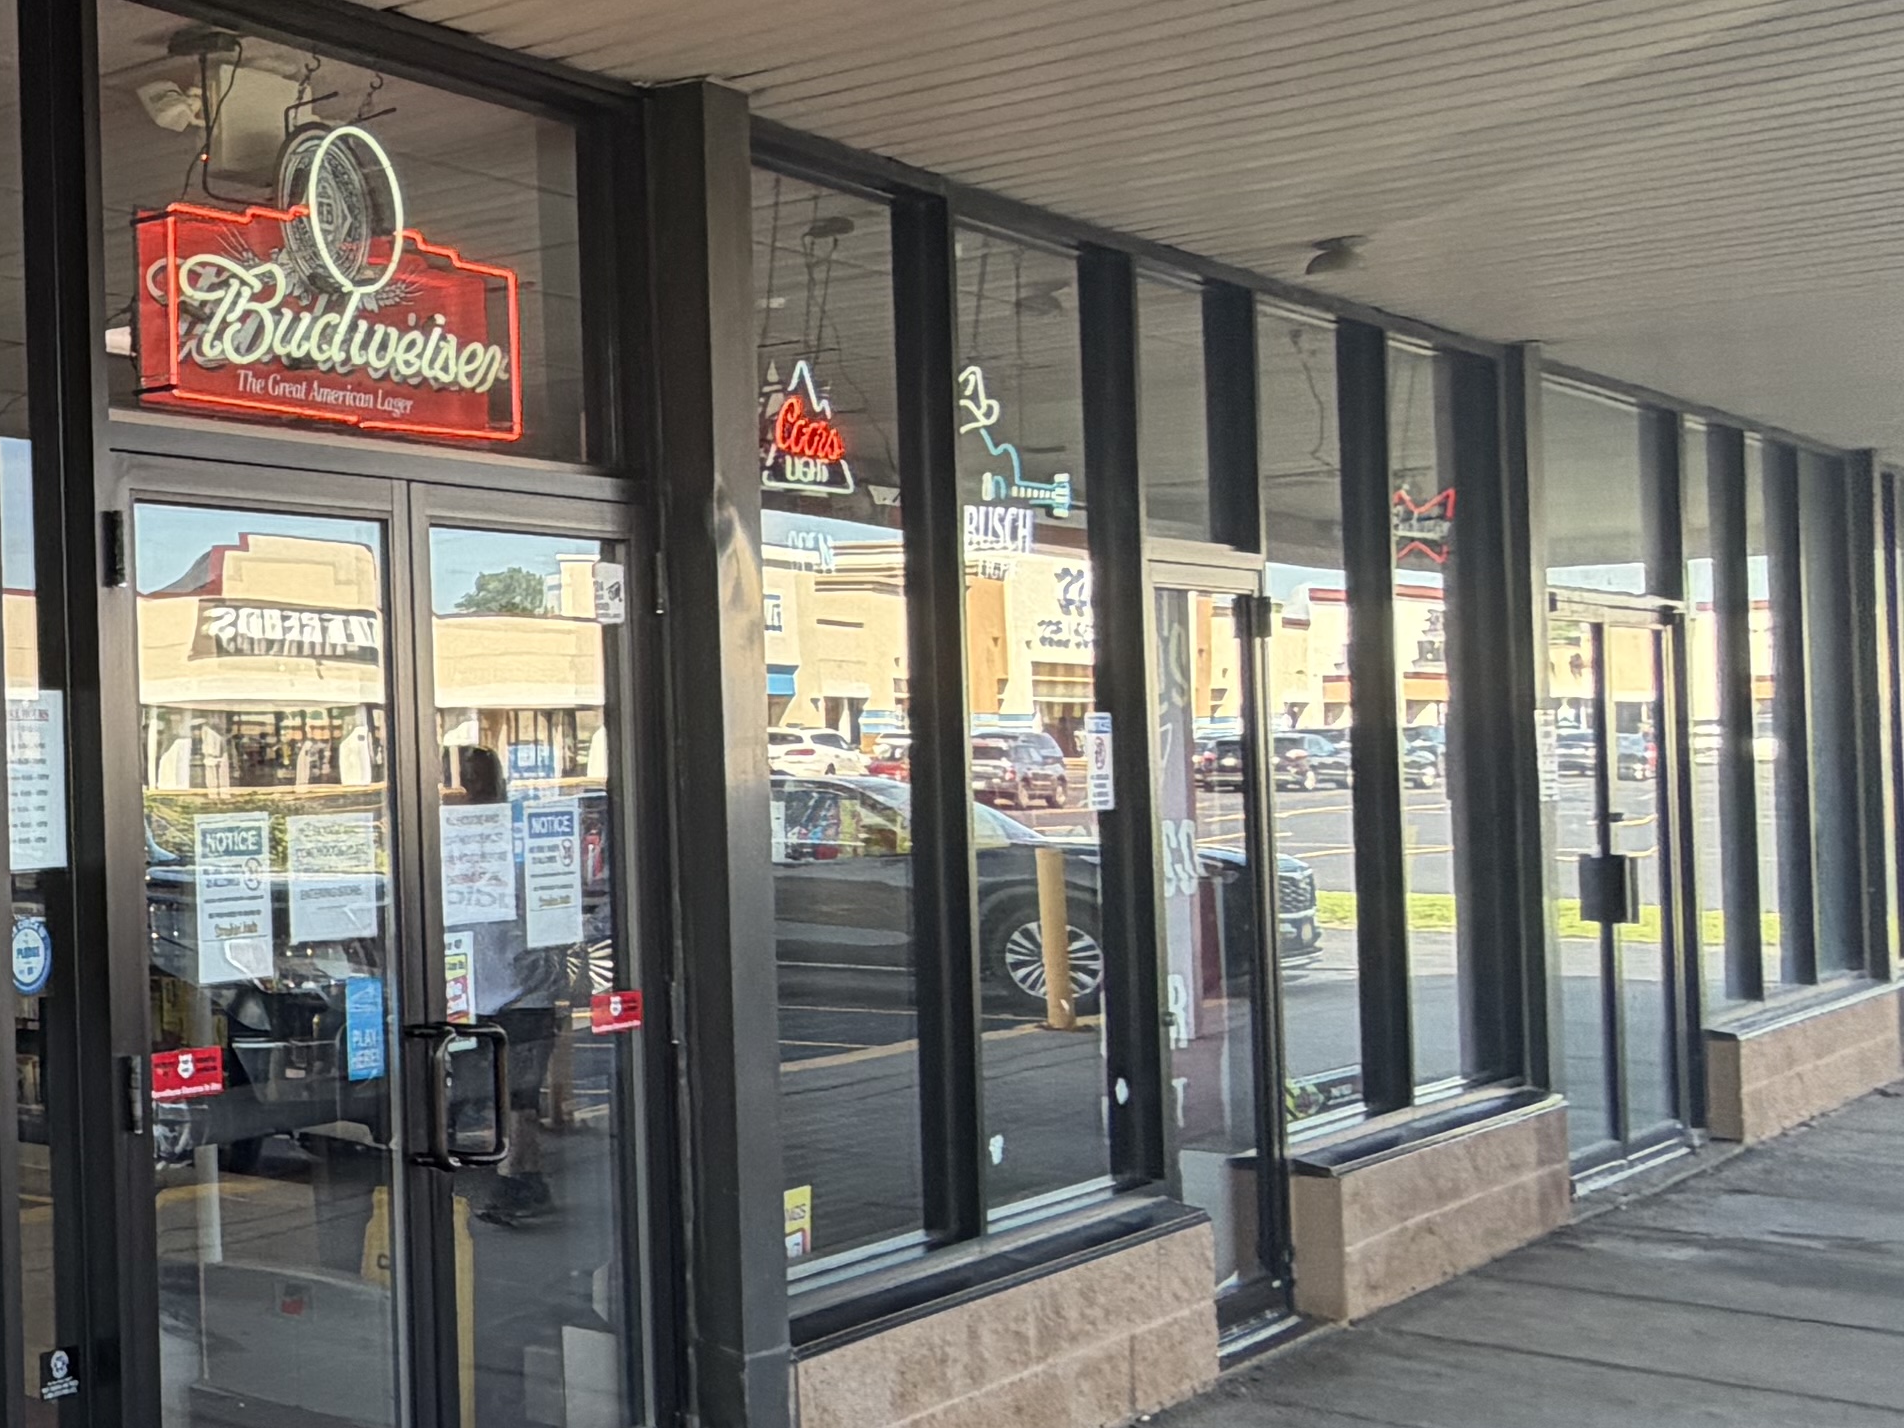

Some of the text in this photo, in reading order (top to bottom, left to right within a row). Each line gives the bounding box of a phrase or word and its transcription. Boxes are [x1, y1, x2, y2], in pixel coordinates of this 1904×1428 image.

[179, 253, 504, 394] Budweiser
[237, 369, 414, 418] The Great American Lager
[963, 505, 1034, 553] BUSCH
[205, 829, 259, 853] NOTICE
[531, 816, 573, 833] NOTICE
[352, 1029, 378, 1048] PLAY
